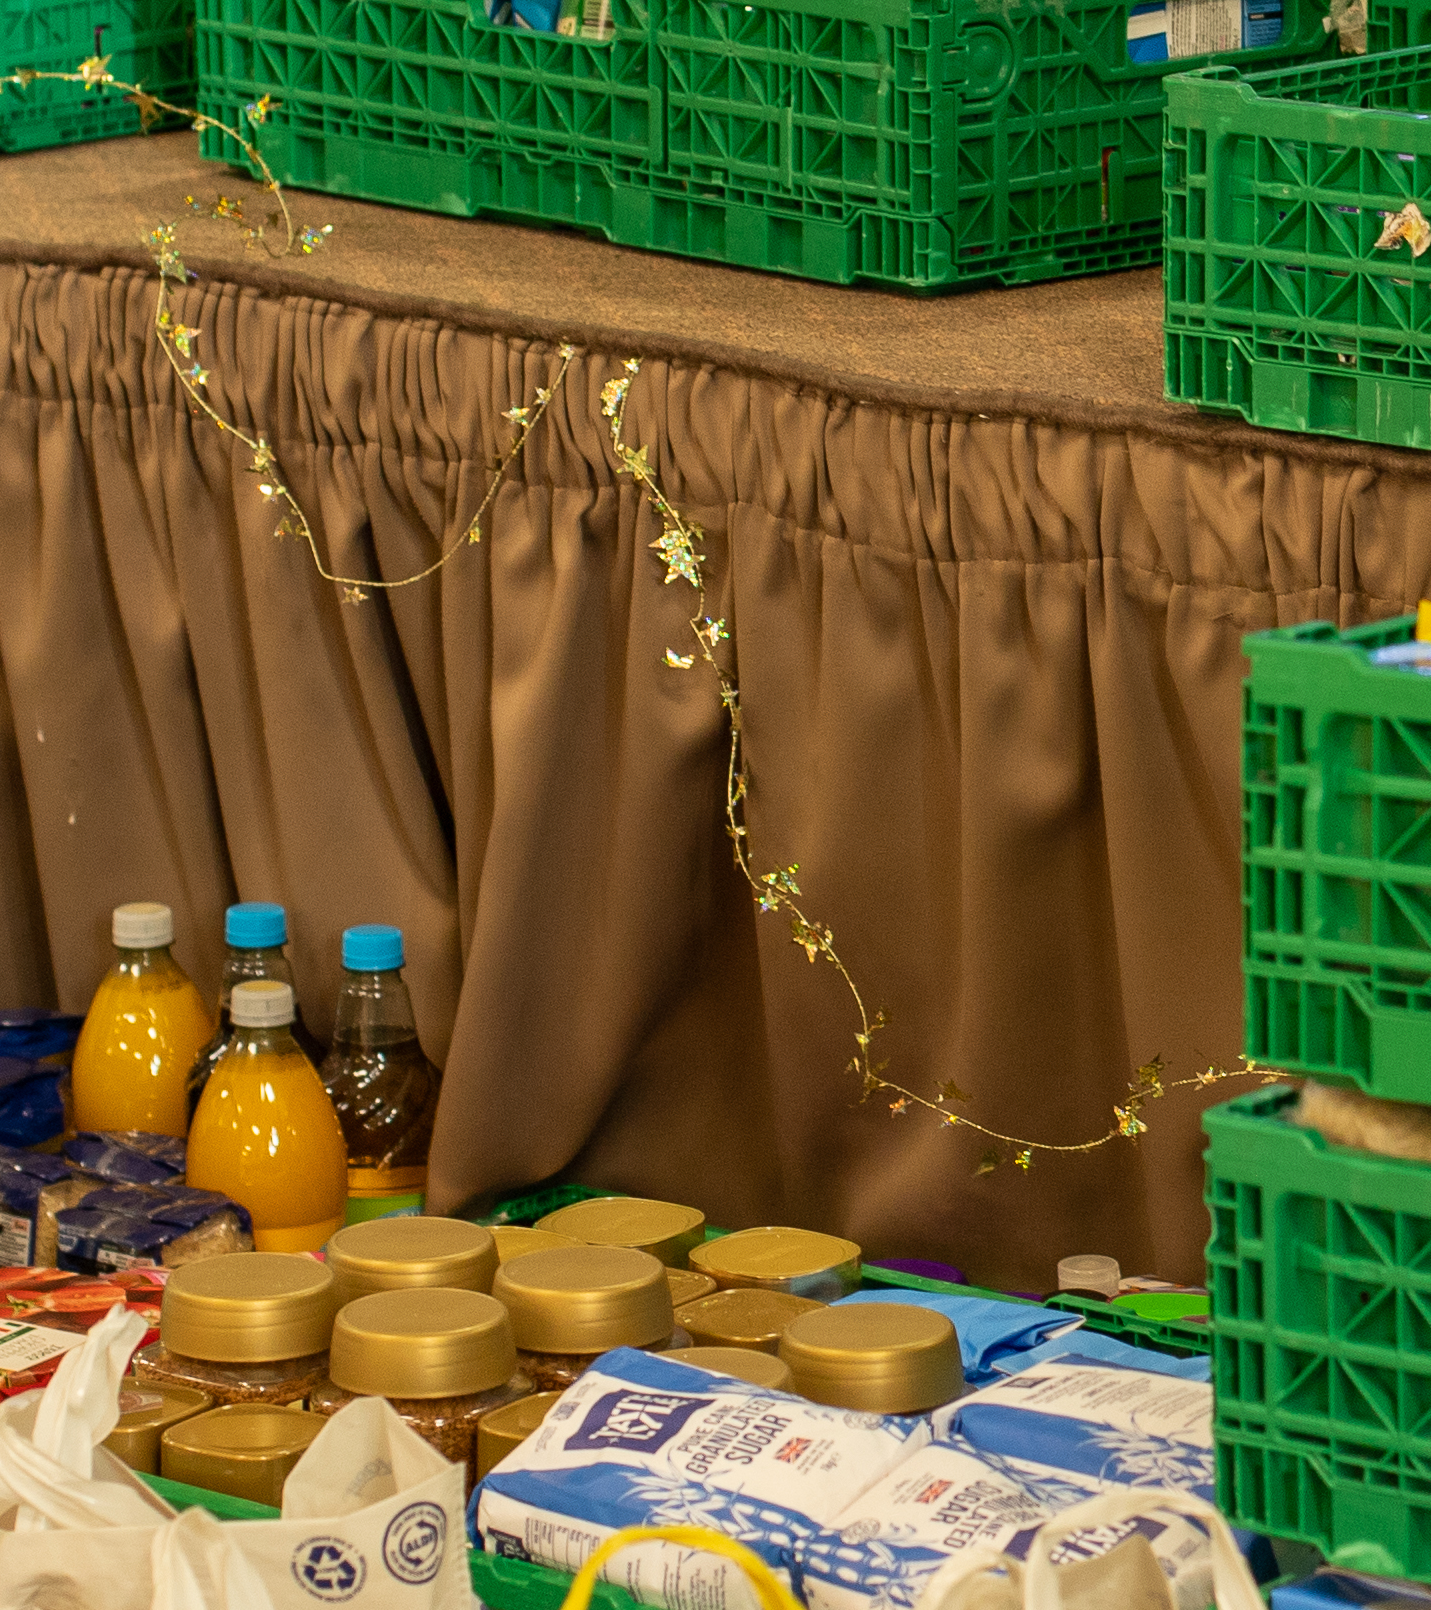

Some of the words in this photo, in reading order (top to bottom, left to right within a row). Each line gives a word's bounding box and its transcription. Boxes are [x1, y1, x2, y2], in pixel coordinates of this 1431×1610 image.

[677, 1420, 712, 1453] PURE
[685, 1398, 776, 1475] GRANULATED
[725, 1413, 793, 1465] SUGAR
[405, 1531, 437, 1553] ALDI
